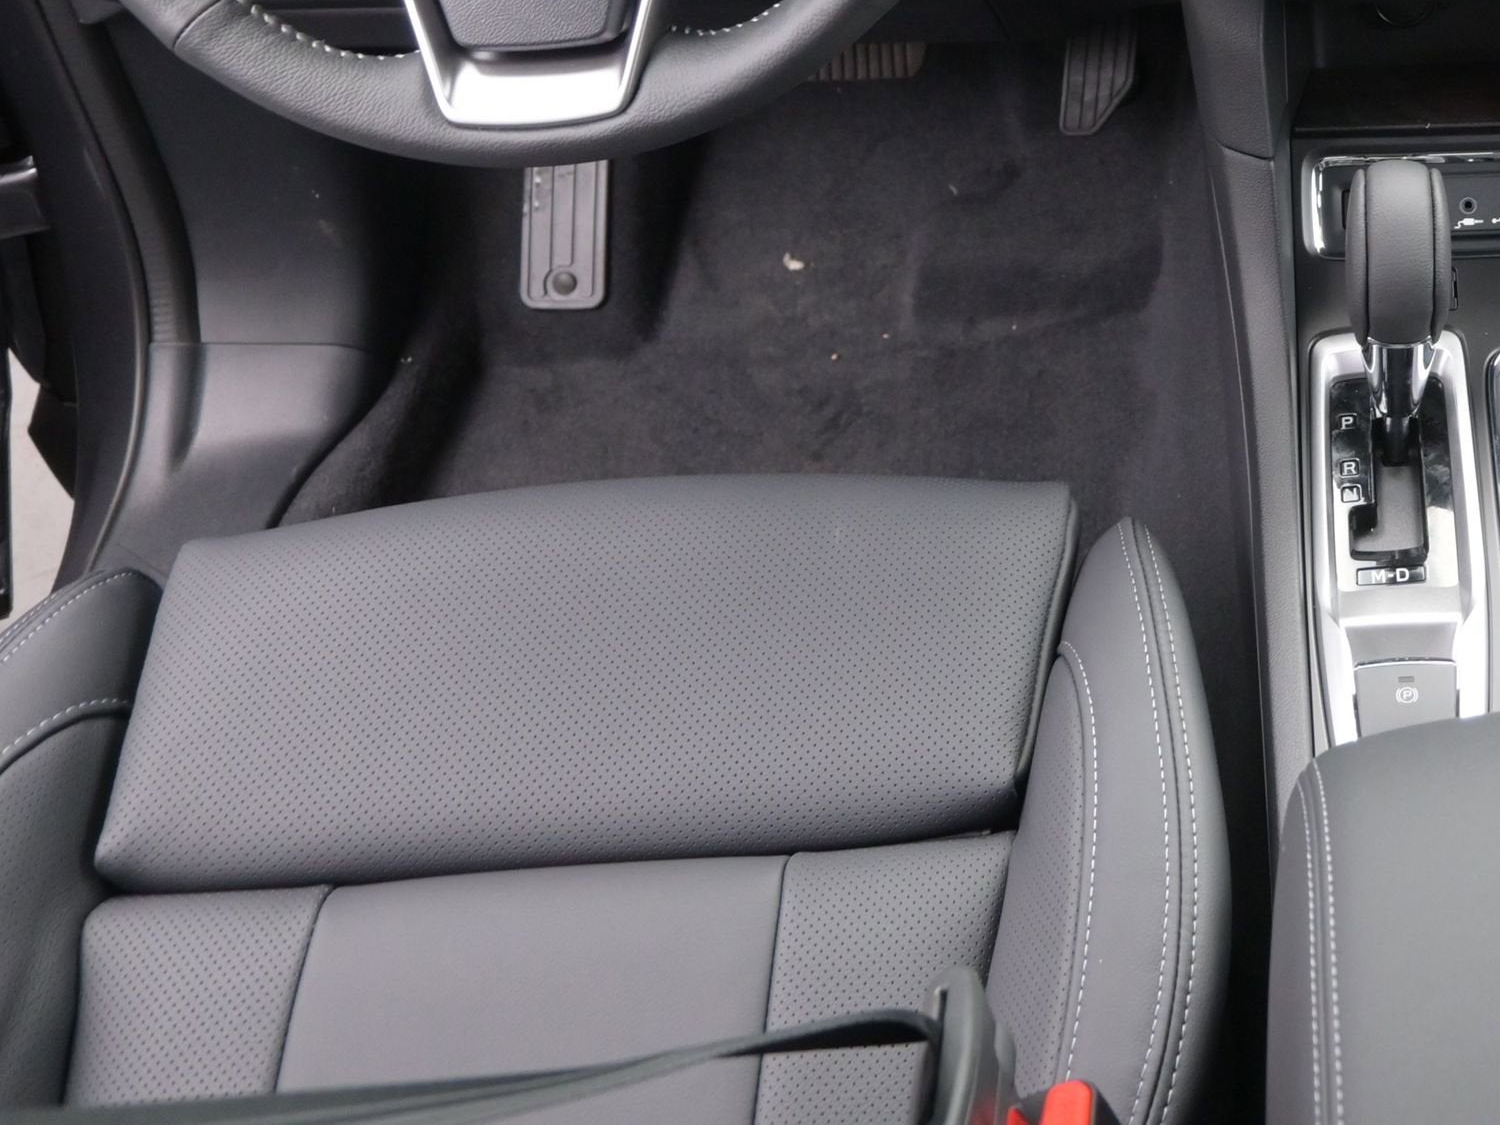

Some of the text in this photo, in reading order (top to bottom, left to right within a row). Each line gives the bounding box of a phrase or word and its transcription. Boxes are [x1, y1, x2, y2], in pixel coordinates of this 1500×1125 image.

[1341, 416, 1354, 430] P
[1342, 462, 1357, 476] R
[1343, 487, 1358, 502] N
